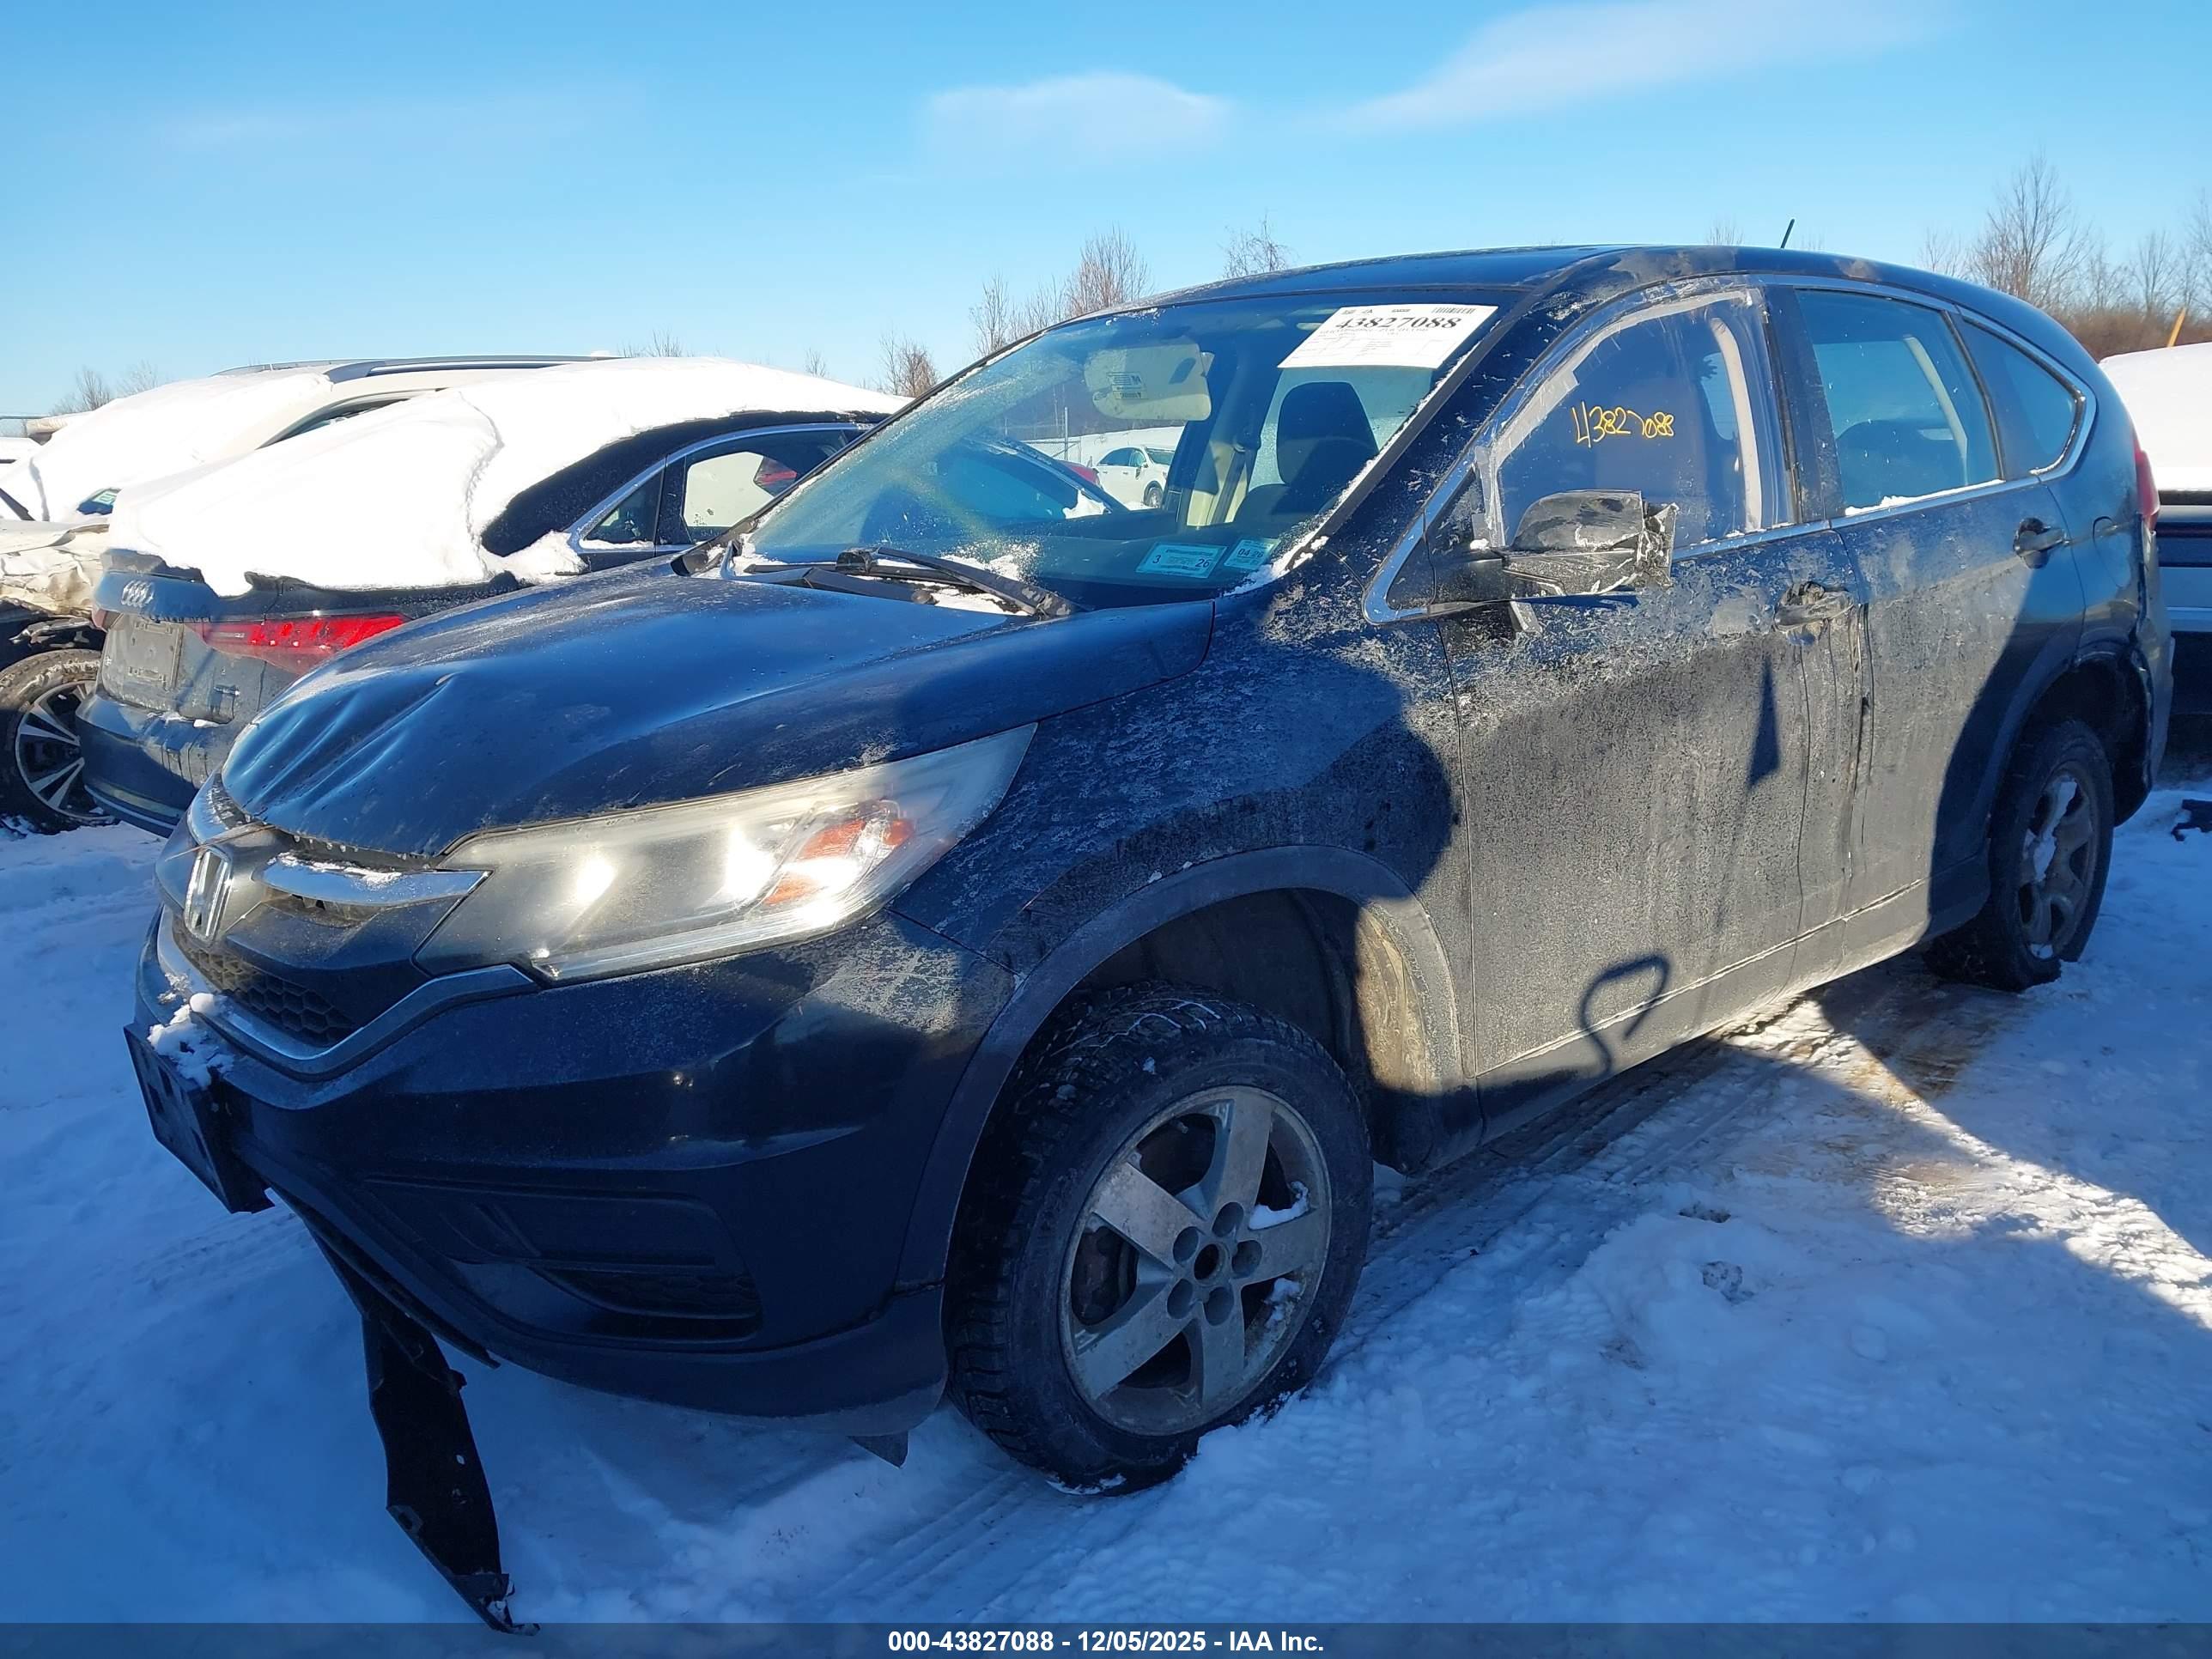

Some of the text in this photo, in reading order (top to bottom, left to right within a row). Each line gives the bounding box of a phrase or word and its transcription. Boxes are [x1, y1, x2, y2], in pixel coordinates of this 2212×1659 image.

[1335, 316, 1462, 329] 43827088
[1572, 401, 1674, 448] 43827088
[1152, 554, 1162, 564] 3
[1194, 558, 1212, 568] 26
